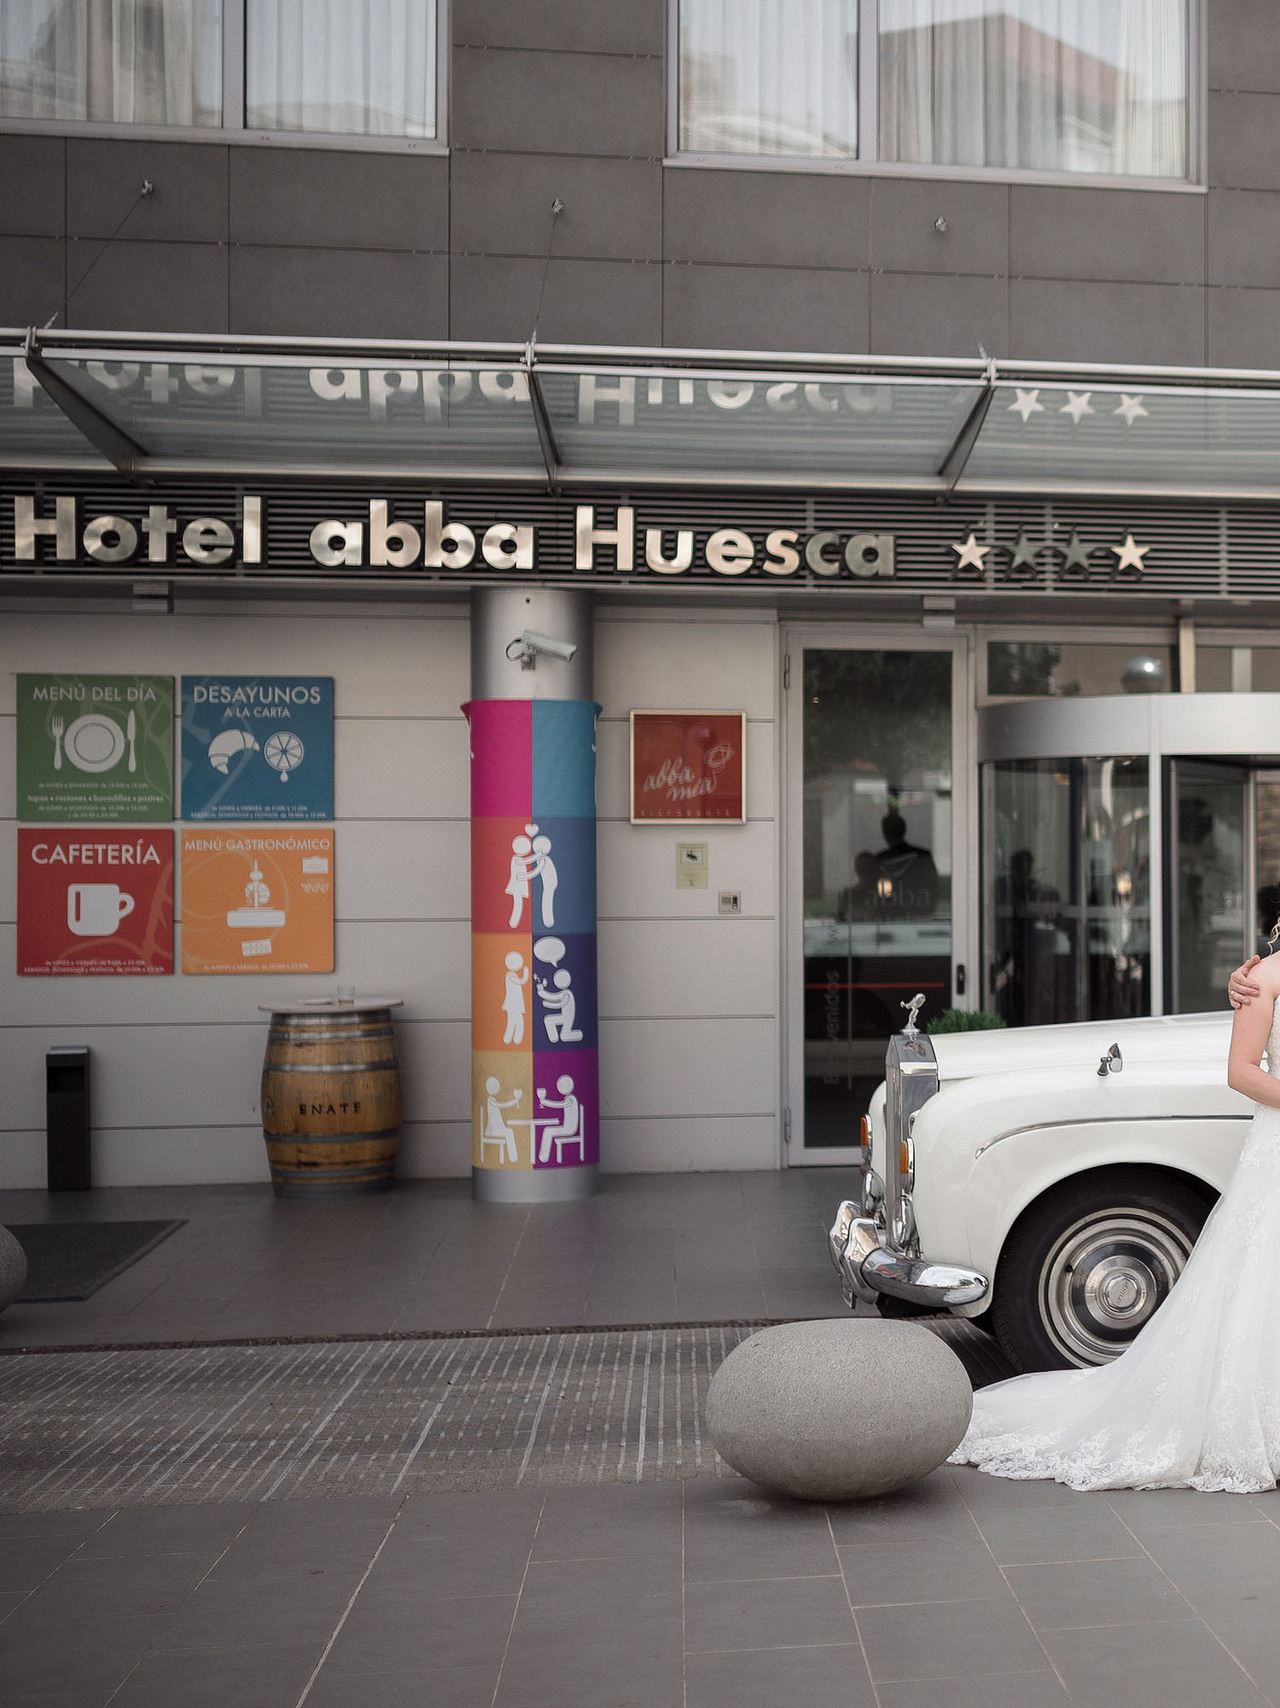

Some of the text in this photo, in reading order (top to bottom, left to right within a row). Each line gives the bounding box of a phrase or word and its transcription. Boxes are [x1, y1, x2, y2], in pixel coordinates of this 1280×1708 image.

[14, 496, 895, 577] Hotel abba Huesca
[33, 683, 156, 701] MENÚ DEL DÍA
[194, 685, 321, 704] DESAYUNOS
[225, 706, 291, 718] A LA CARTA
[31, 838, 161, 865] CAFETERÍA
[184, 836, 330, 851] MENÚ GASTRONÓMICO
[298, 1102, 361, 1115] ENATE
